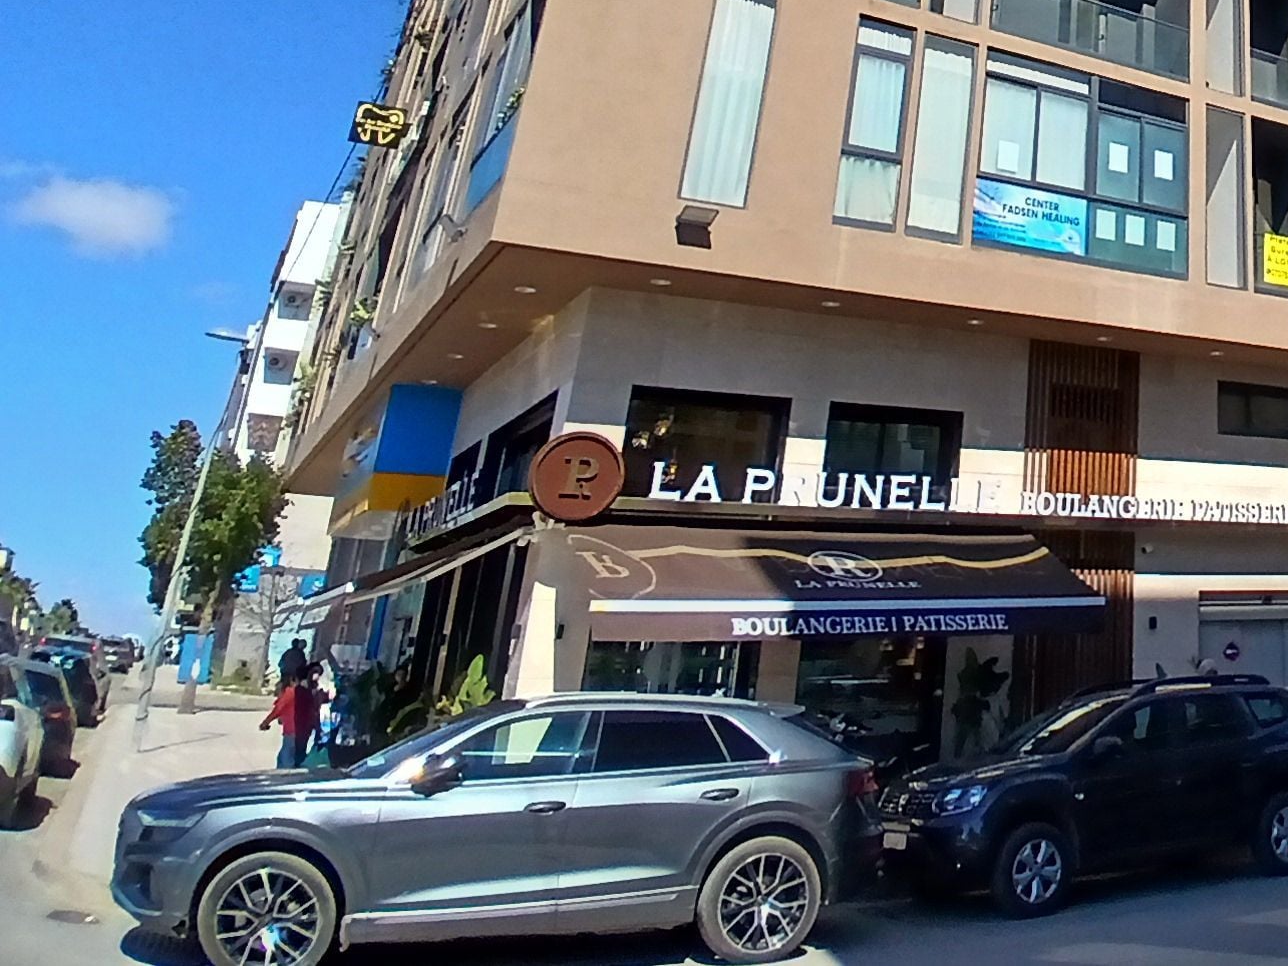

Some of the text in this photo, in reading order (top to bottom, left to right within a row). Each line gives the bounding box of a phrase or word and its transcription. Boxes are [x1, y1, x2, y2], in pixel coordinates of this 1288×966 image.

[1002, 203, 1080, 227] FADSEN HEALING
[1024, 196, 1060, 212] CENTER
[648, 461, 722, 503] LA
[1019, 491, 1185, 521] BOULANGERIE
[730, 616, 889, 636] BOULANGERIE
[902, 614, 1009, 632] PATISSERIE
